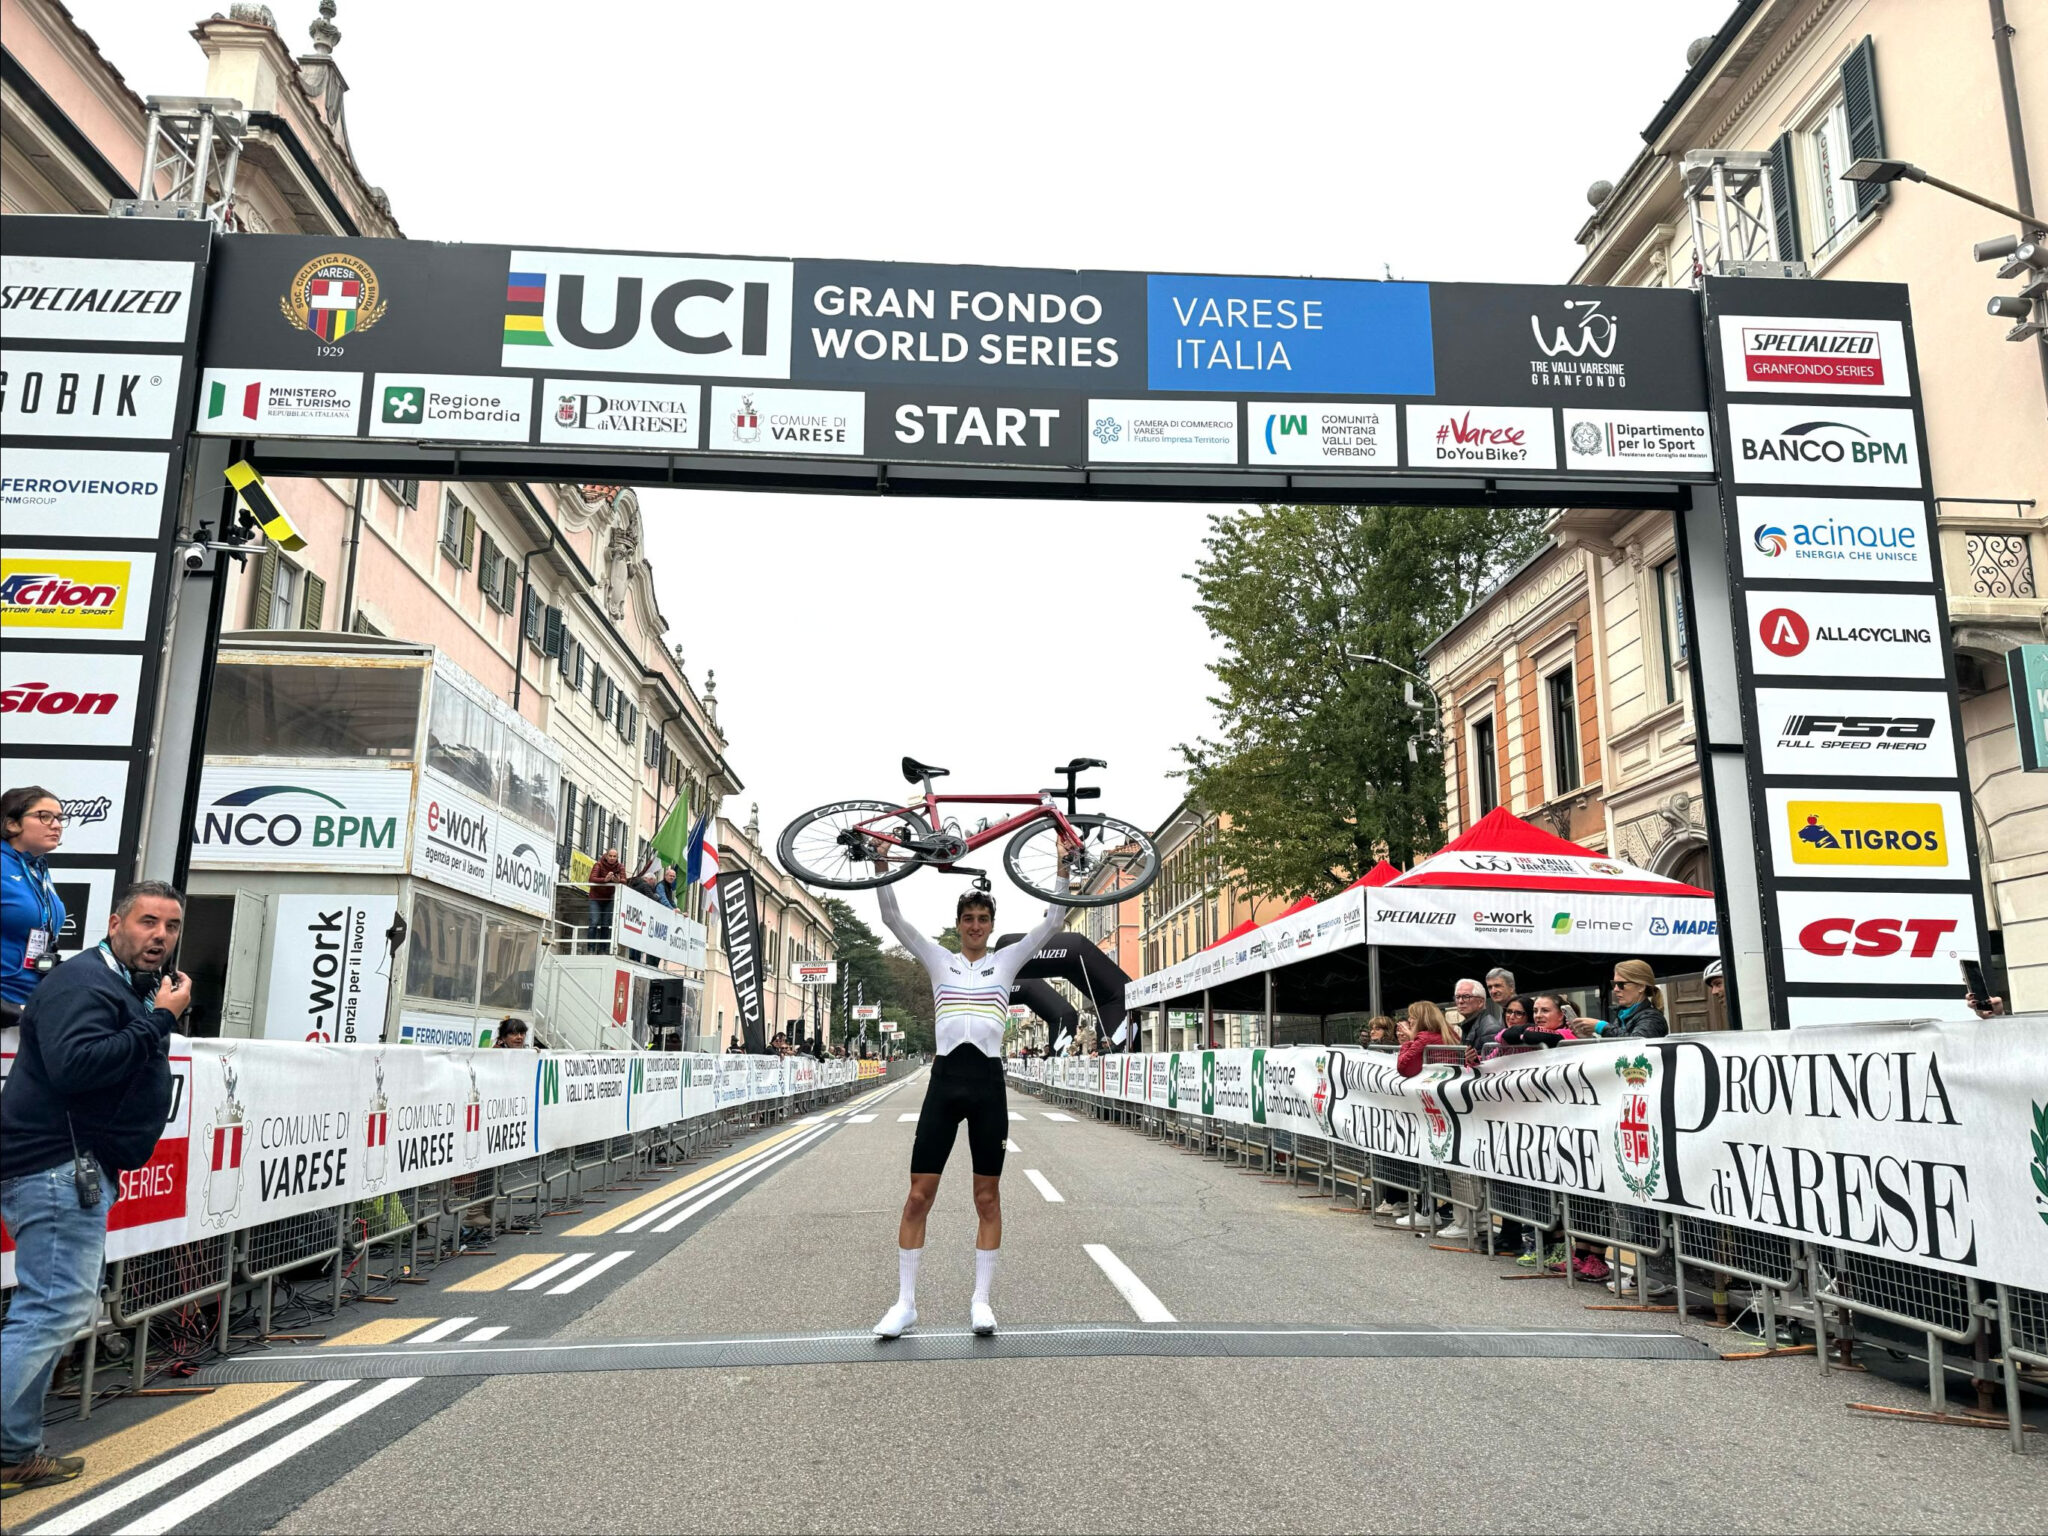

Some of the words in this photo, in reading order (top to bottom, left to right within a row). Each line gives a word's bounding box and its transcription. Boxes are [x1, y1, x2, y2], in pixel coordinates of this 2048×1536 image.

[296, 255, 339, 287] CICLISTICA
[341, 256, 374, 285] ALFREDO
[361, 285, 376, 312] BINDA
[317, 267, 355, 279] VARESE
[0, 285, 182, 315] SPECIALIZED
[813, 285, 935, 319] GRAN
[950, 290, 1103, 325] FONDO
[556, 274, 769, 356] UCI
[1172, 297, 1323, 330] VARESE
[316, 346, 345, 358] 1929
[811, 327, 969, 363] WORLD
[978, 333, 1119, 368] SERIES
[1176, 339, 1293, 371] ITALIA
[1750, 333, 1874, 355] SPECIALIZED
[1531, 361, 1548, 374] TRE
[1552, 361, 1576, 374] VALLI
[1580, 362, 1625, 375] VARESINE
[1531, 373, 1626, 388] GRANFONDO
[1753, 362, 1833, 377] GRANFONDO
[1836, 364, 1875, 378] SERIES
[268, 397, 294, 407] DEL
[298, 398, 352, 409] TURISMO
[269, 387, 337, 399] MINISTERO
[429, 393, 501, 410] Regione
[428, 408, 520, 422] Lombardia
[577, 393, 687, 430] PROVINCIA
[598, 419, 609, 430] di
[609, 415, 687, 433] VARESE
[770, 414, 828, 427] COMUNE
[833, 416, 847, 427] DI
[1133, 419, 1168, 427] CAMERA
[1181, 420, 1234, 428] COMMERCIO
[772, 426, 846, 443] VARESE
[895, 404, 1060, 447] START
[1133, 427, 1165, 435] VARESE
[1436, 409, 1527, 446] #Varese
[1616, 423, 1705, 439] Dipartimento
[1134, 435, 1160, 443] Futuro
[1194, 436, 1230, 444] Territorio
[1618, 439, 1640, 451] per
[1643, 438, 1655, 449] lo
[1658, 438, 1696, 453] Sport
[1742, 437, 1845, 463] BANCO
[1852, 442, 1908, 465] BPM
[1, 478, 159, 496] FERROVIENORD
[1793, 518, 1915, 550] acinque
[1795, 550, 1844, 561] ENERGIA
[1848, 551, 1873, 561] CHE
[1877, 552, 1918, 562] UNISCE
[80, 608, 115, 616] SPORT
[1815, 625, 1931, 644] ALL4CYCLING
[1777, 740, 1815, 749] FULL
[1821, 741, 1871, 750] SPEED
[1876, 742, 1927, 751] AHEAD
[193, 812, 301, 847] NCO
[312, 815, 397, 849] BPM
[427, 801, 488, 854] e-work
[1840, 828, 1939, 852] TIGROS
[425, 846, 451, 864] agenzia
[450, 856, 463, 871] per
[467, 860, 485, 879] lavoro
[495, 853, 532, 891] BANCO
[533, 869, 551, 899] BPM
[1374, 909, 1457, 926] SPECIALIZED
[1473, 909, 1533, 925] e-work
[1576, 919, 1633, 931] elmec
[350, 910, 367, 954] lavoro
[1798, 917, 1958, 959] CST
[349, 958, 362, 966] il
[349, 968, 361, 993] per
[415, 1026, 473, 1047] FERROVIENORD
[1178, 1062, 1195, 1084] Regione
[1215, 1061, 1242, 1087] Regione
[1265, 1061, 1297, 1091] Regione
[486, 1097, 519, 1121] COMUNE
[520, 1096, 528, 1117] DI
[1215, 1084, 1249, 1109] Lombardia
[1265, 1090, 1311, 1119] Lombardia
[397, 1103, 443, 1132] COMUNE
[445, 1102, 456, 1126] DI
[1646, 1041, 1963, 1210] PROVINCIA
[260, 1112, 330, 1150] COMUNE
[336, 1111, 350, 1140] DI
[486, 1120, 527, 1155] VARESE
[1351, 1103, 1420, 1159] VARESE
[397, 1131, 454, 1174] VARESE
[1473, 1138, 1488, 1172] di
[1484, 1119, 1606, 1194] VARESE
[118, 1163, 174, 1203] SERIES
[259, 1147, 348, 1203] VARESE
[1710, 1168, 1736, 1218] di
[1722, 1141, 1977, 1267] VARESE
